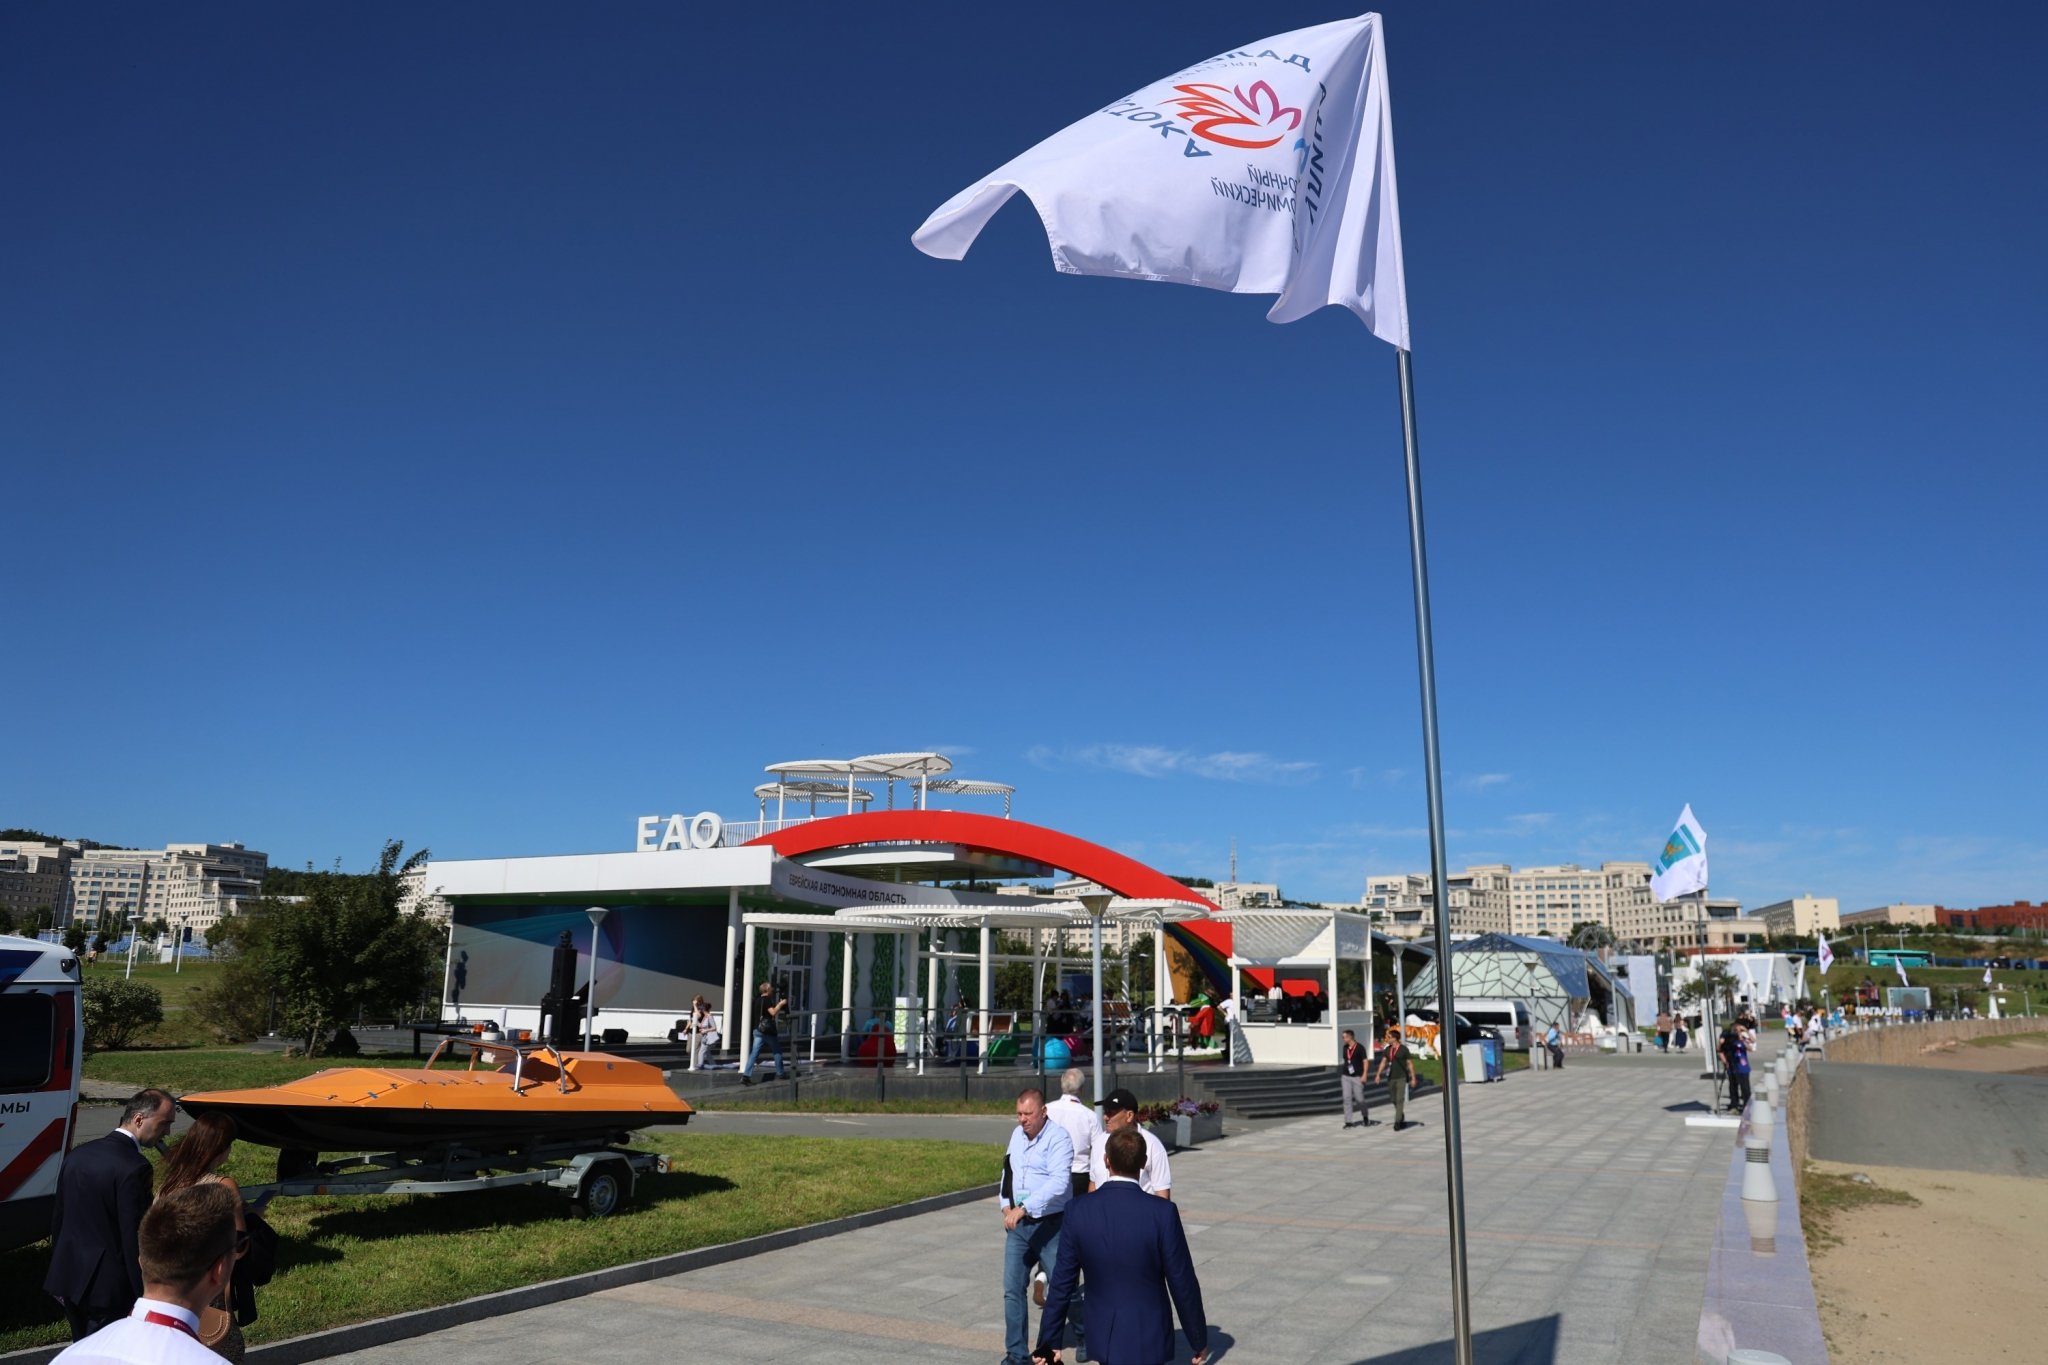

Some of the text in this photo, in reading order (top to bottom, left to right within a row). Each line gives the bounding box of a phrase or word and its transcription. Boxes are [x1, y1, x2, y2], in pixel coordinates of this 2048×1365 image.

[637, 812, 722, 852] ЕАО
[789, 873, 907, 905] ЕВРЕЙСКАЯ АВТОНОМНАЯ ОБЛАСТЬ
[0, 1101, 31, 1115] МЫ
